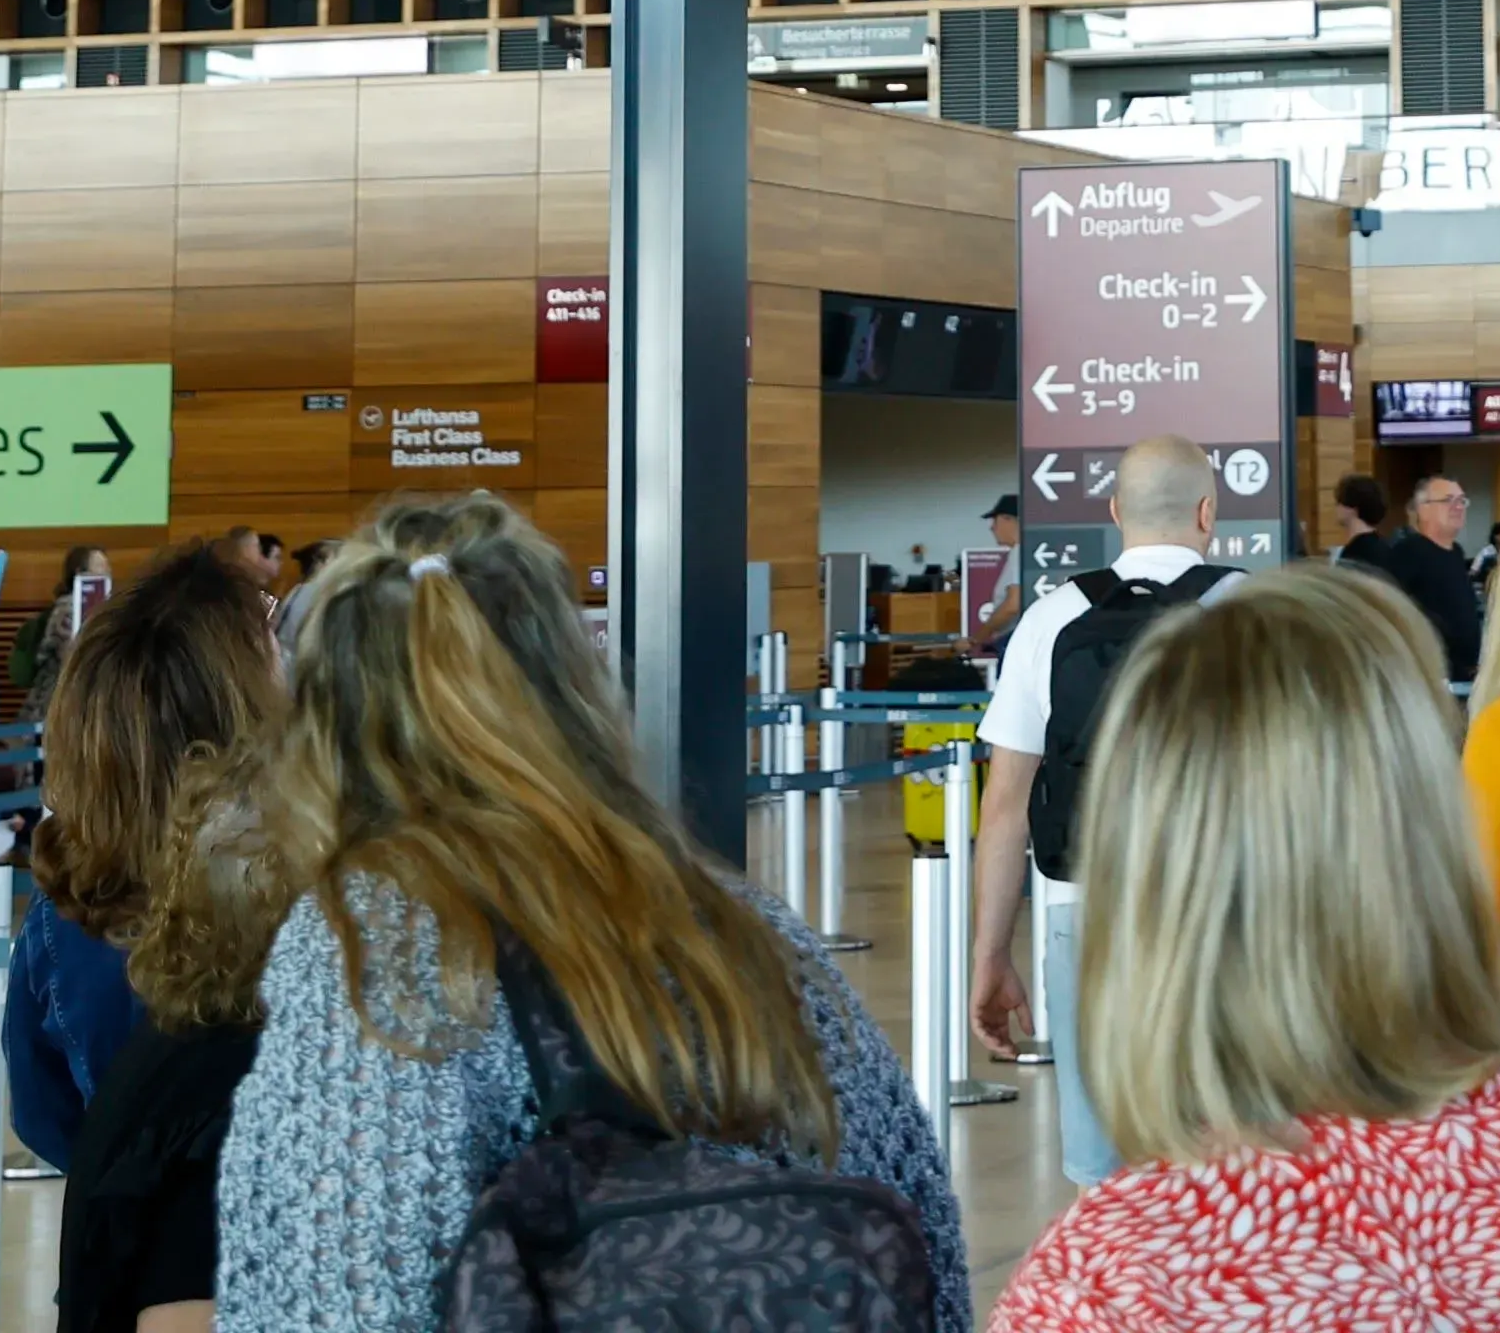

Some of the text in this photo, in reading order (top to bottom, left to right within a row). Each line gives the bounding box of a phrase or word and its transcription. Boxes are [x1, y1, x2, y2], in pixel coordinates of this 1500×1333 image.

[1078, 181, 1171, 214] Abflug
[1080, 214, 1184, 241] Departure
[547, 288, 606, 303] Check-in
[1098, 270, 1217, 300] Check-in
[1080, 355, 1200, 385] Check-in
[392, 409, 479, 426] Lufthansa
[392, 428, 482, 446] First Class
[392, 448, 520, 467] Business Class
[1231, 460, 1261, 484] T2
